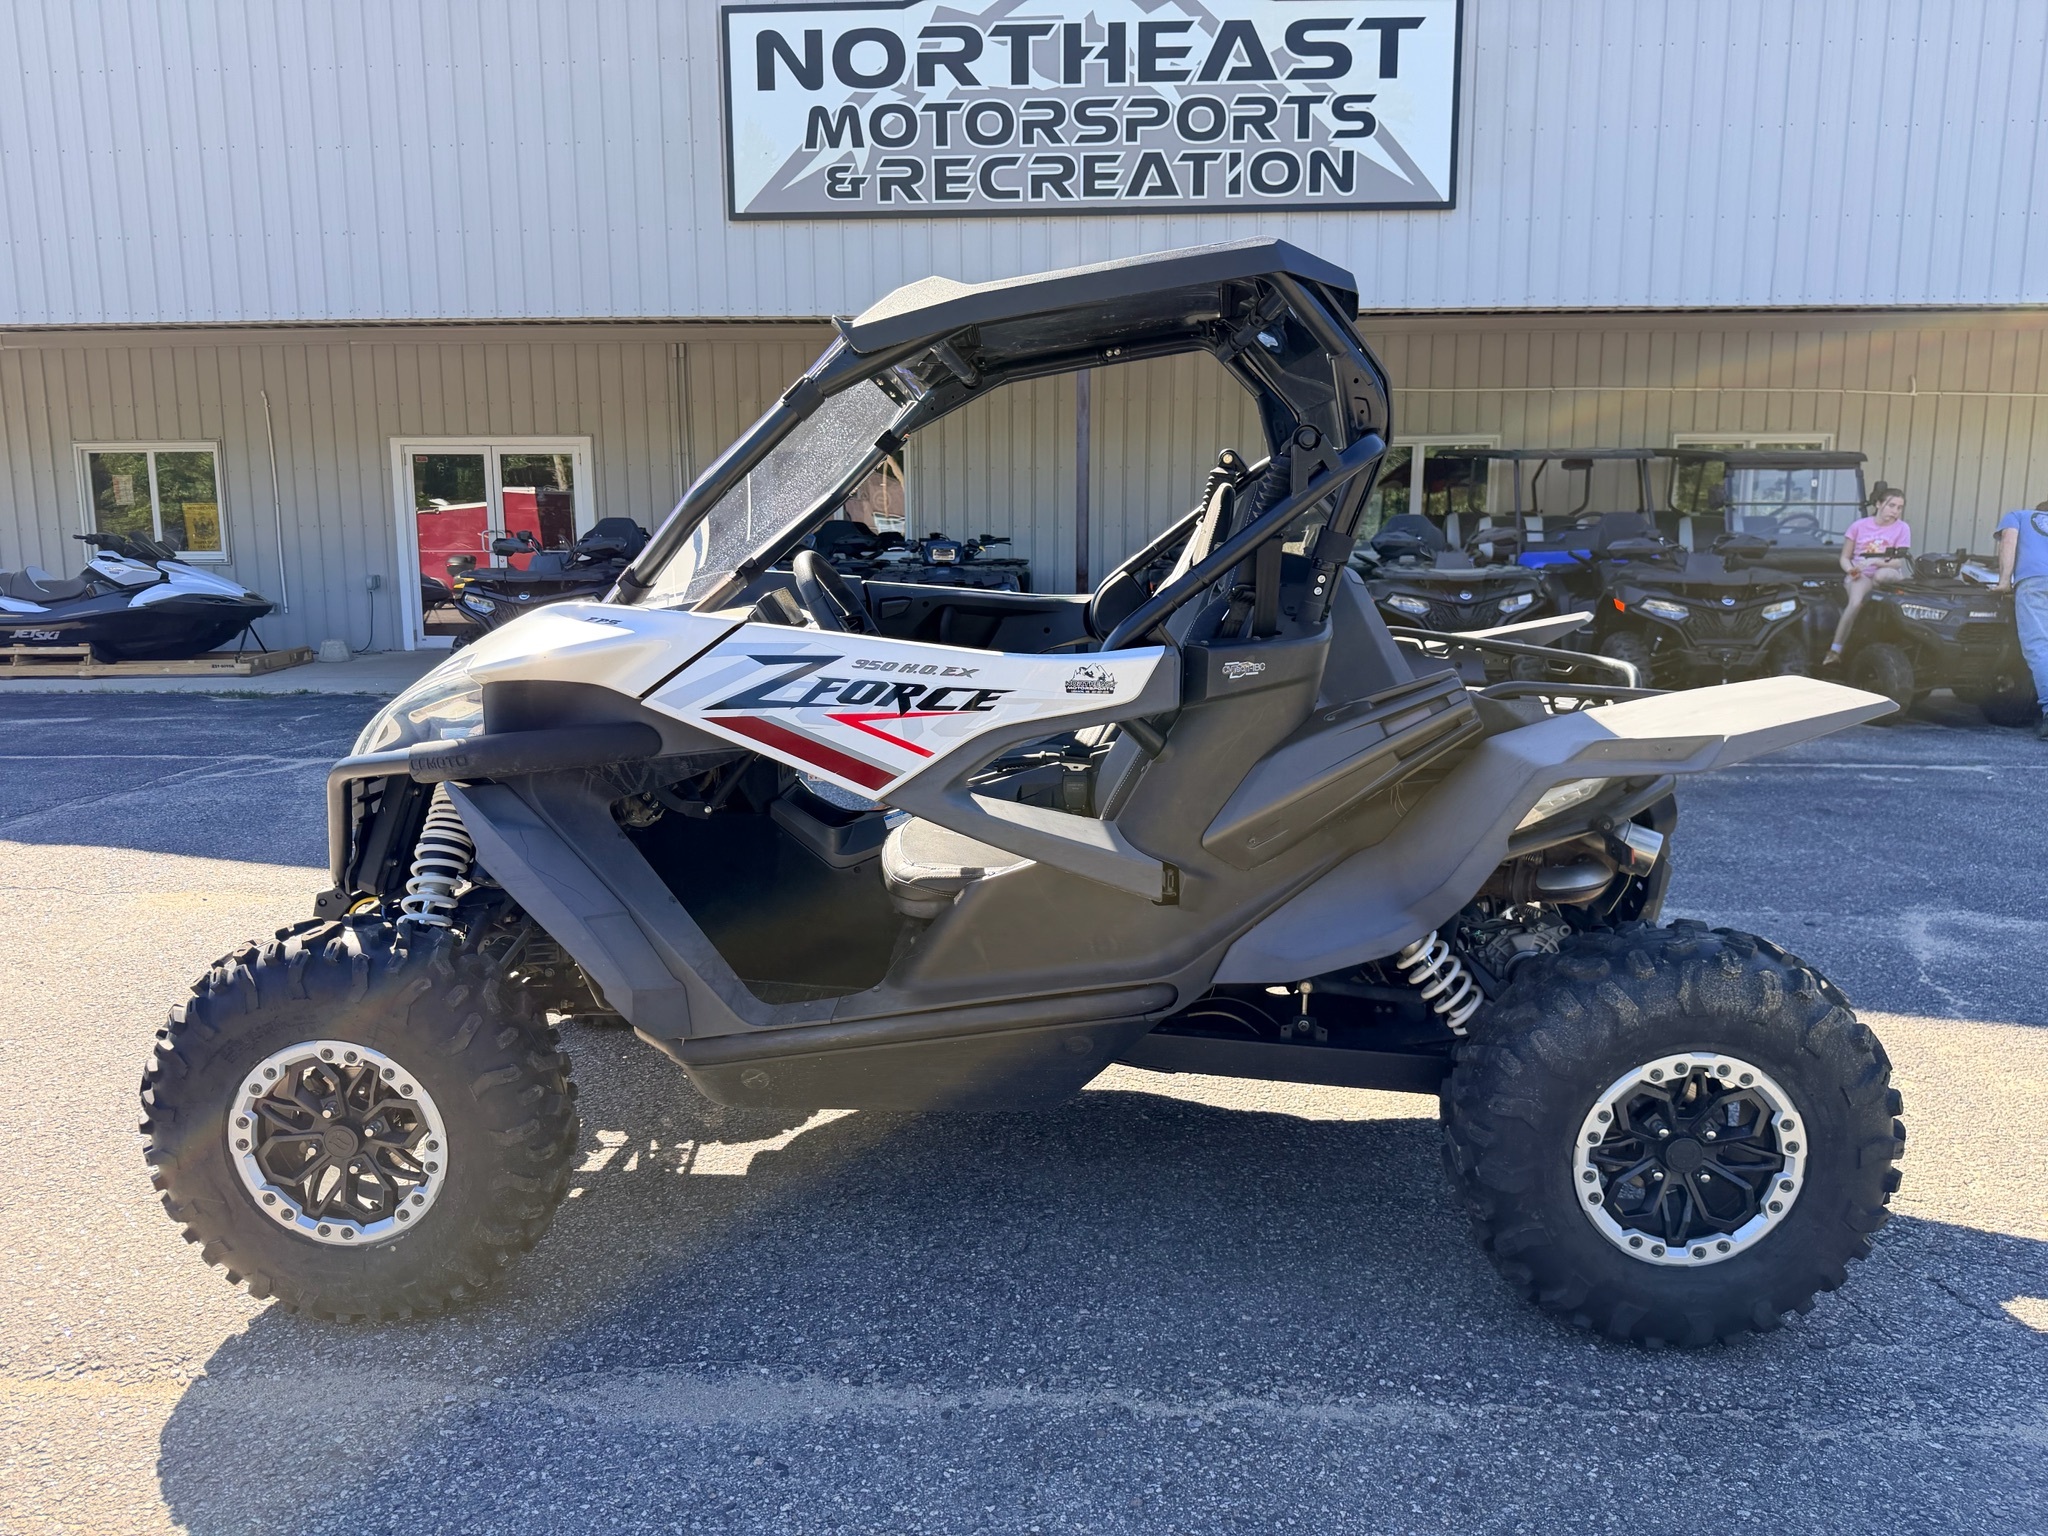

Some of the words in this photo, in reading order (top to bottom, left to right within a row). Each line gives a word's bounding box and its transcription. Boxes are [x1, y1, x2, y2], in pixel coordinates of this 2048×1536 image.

[755, 16, 1427, 92] NORTHEAST
[803, 93, 1378, 149] MOTORSPORTS
[825, 165, 868, 200] &
[878, 149, 1356, 202] RECREATION
[851, 659, 900, 672] 950
[897, 663, 939, 676] H.O.
[939, 666, 980, 679] EX
